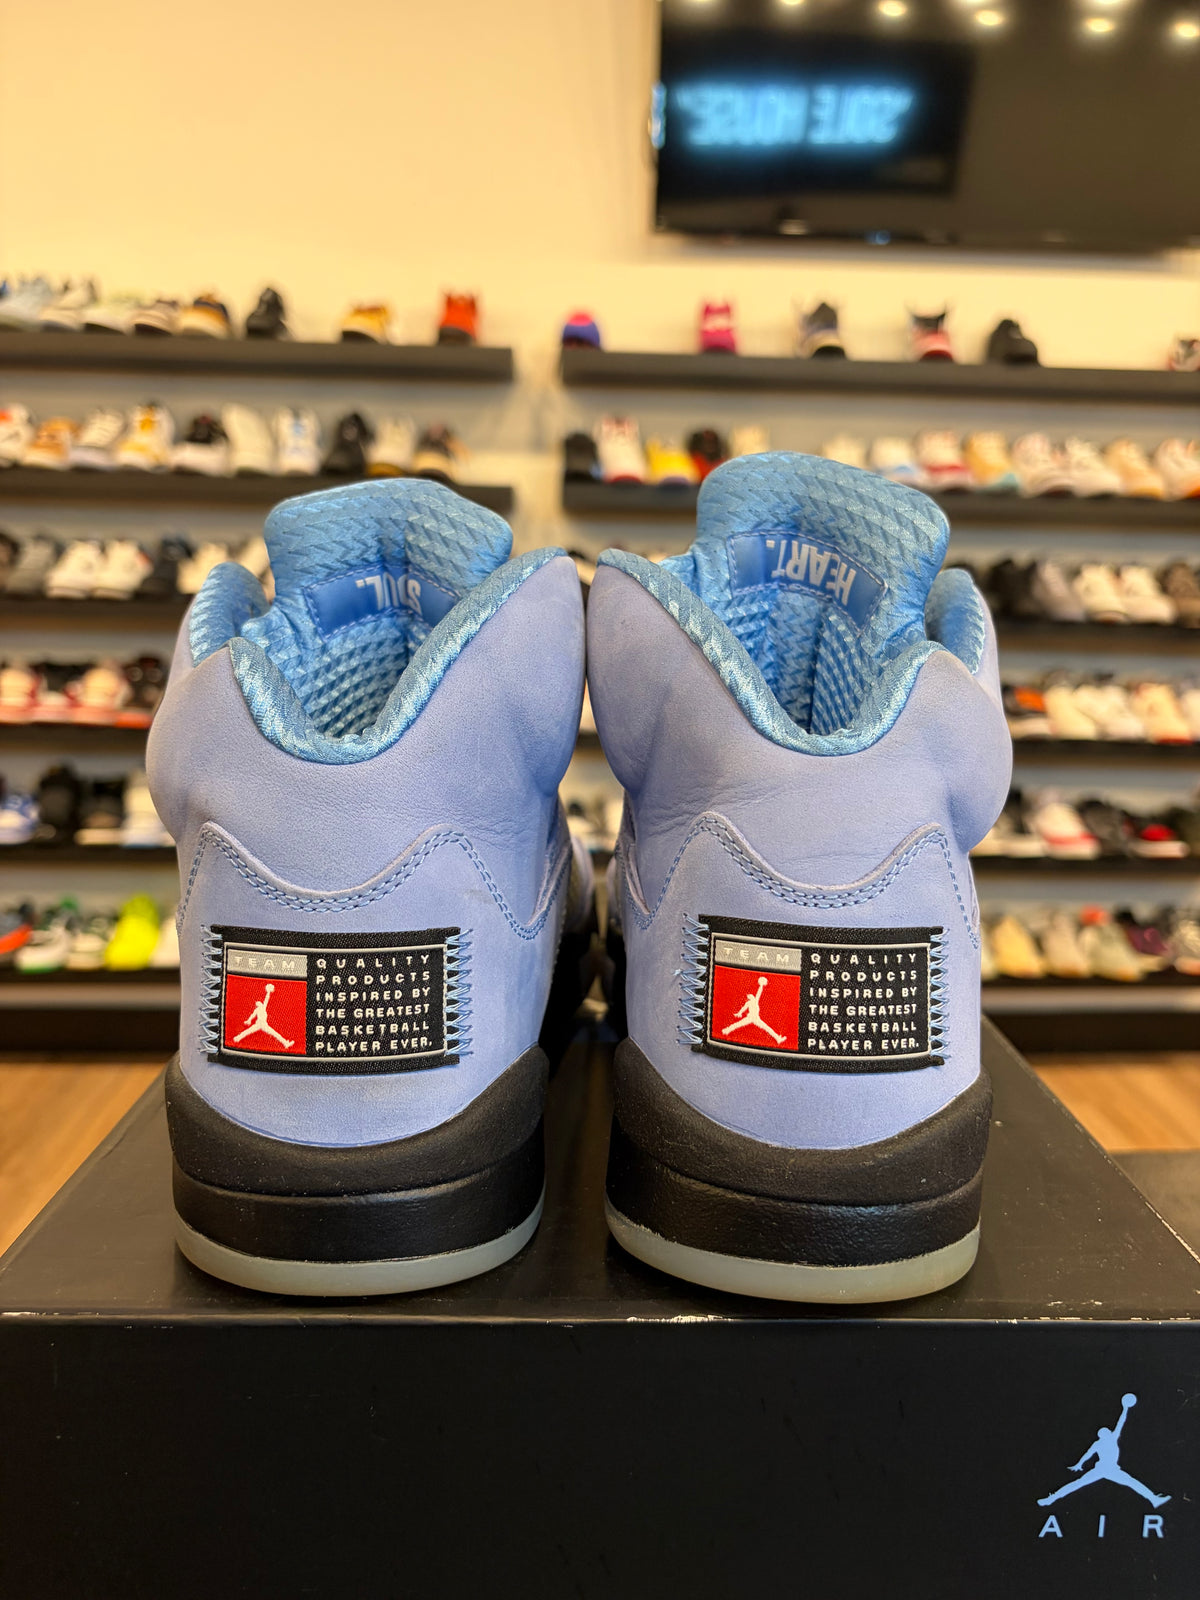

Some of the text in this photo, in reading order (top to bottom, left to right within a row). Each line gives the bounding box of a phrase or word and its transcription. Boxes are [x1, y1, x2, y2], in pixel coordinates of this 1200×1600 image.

[315, 954, 430, 969] QUALITY
[723, 947, 790, 963] TEAM
[810, 953, 917, 965] QUALITY
[234, 957, 296, 970] TEAM
[315, 971, 431, 985] PRODUCTS
[809, 970, 918, 982] PRODUCTS
[315, 987, 431, 1002] INSPIRED BY
[809, 987, 918, 999] INSPIRED BY
[315, 1004, 430, 1019] THE GREATEST
[808, 1004, 918, 1016] THE GREATEST
[315, 1021, 430, 1036] BASKETBALL
[807, 1021, 917, 1033] BASKETBALL
[315, 1040, 381, 1052] PLAYER
[807, 1038, 919, 1050] PLAYER EVER.
[1038, 1514, 1164, 1538] AIR
